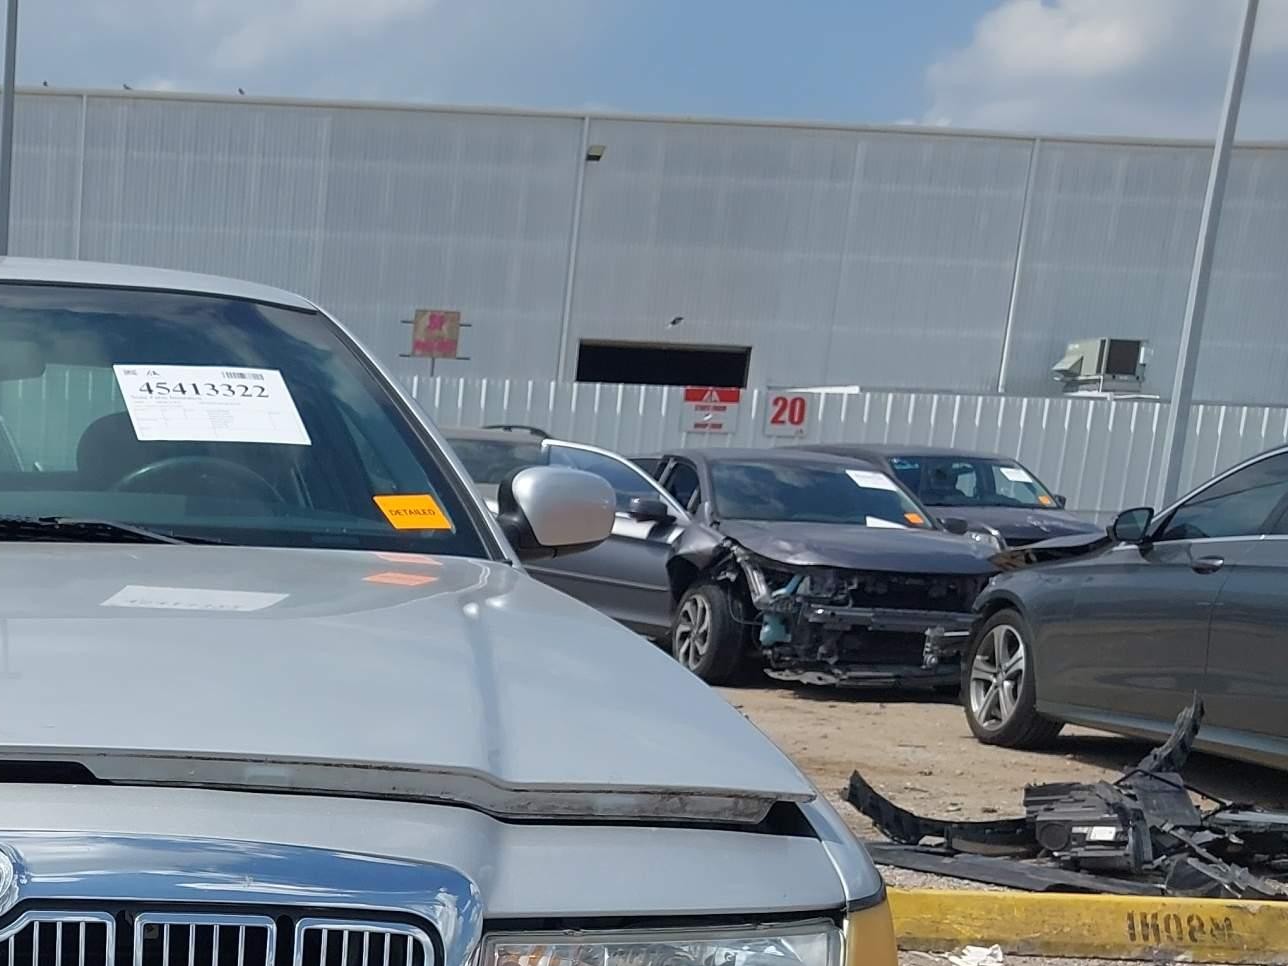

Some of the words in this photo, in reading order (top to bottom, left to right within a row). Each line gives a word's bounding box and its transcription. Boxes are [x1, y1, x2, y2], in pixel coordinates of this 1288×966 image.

[139, 381, 270, 398] 45413322
[770, 396, 806, 425] 20
[389, 509, 436, 517] DETAILED
